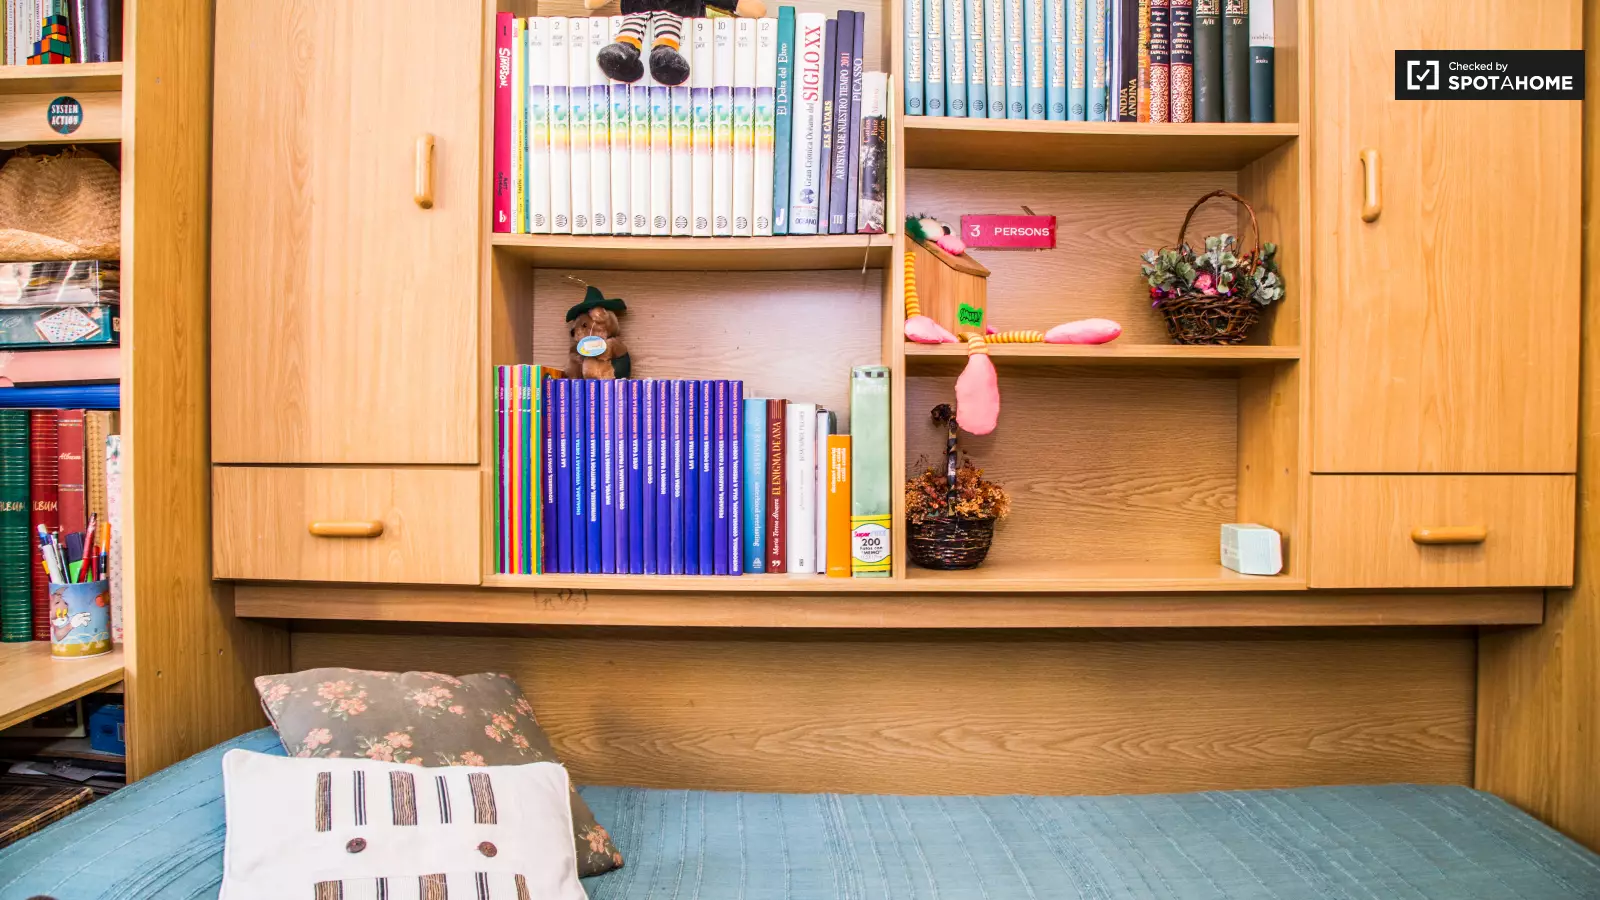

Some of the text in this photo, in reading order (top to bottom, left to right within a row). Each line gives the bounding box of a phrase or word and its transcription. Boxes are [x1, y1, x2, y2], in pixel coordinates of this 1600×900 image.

[804, 26, 821, 47] XX
[777, 43, 788, 116] El Delta del Ebro
[802, 52, 820, 102] SIGLO
[853, 58, 863, 102] PICASSO
[909, 40, 920, 82] Historia
[928, 40, 940, 83] Historia
[972, 41, 984, 84] Historia
[992, 43, 1003, 86] Historia
[1031, 45, 1043, 88] Historia
[1072, 47, 1084, 88] Historia
[1092, 46, 1104, 88] Historia
[52, 104, 78, 114] SYSTEM
[805, 103, 814, 113] del
[836, 52, 850, 180] ARTISTAS DE NUESTRO TIEMPO 2011
[1120, 88, 1128, 116] INDIA
[1129, 78, 1137, 117] ANDINA
[52, 116, 79, 125] ACTION
[970, 225, 1050, 237] 3 PERSONS
[772, 422, 781, 440] ANA
[772, 441, 781, 451] DE
[772, 453, 781, 485] ENIGMA
[772, 486, 781, 495] EL
[862, 538, 880, 546] 200
